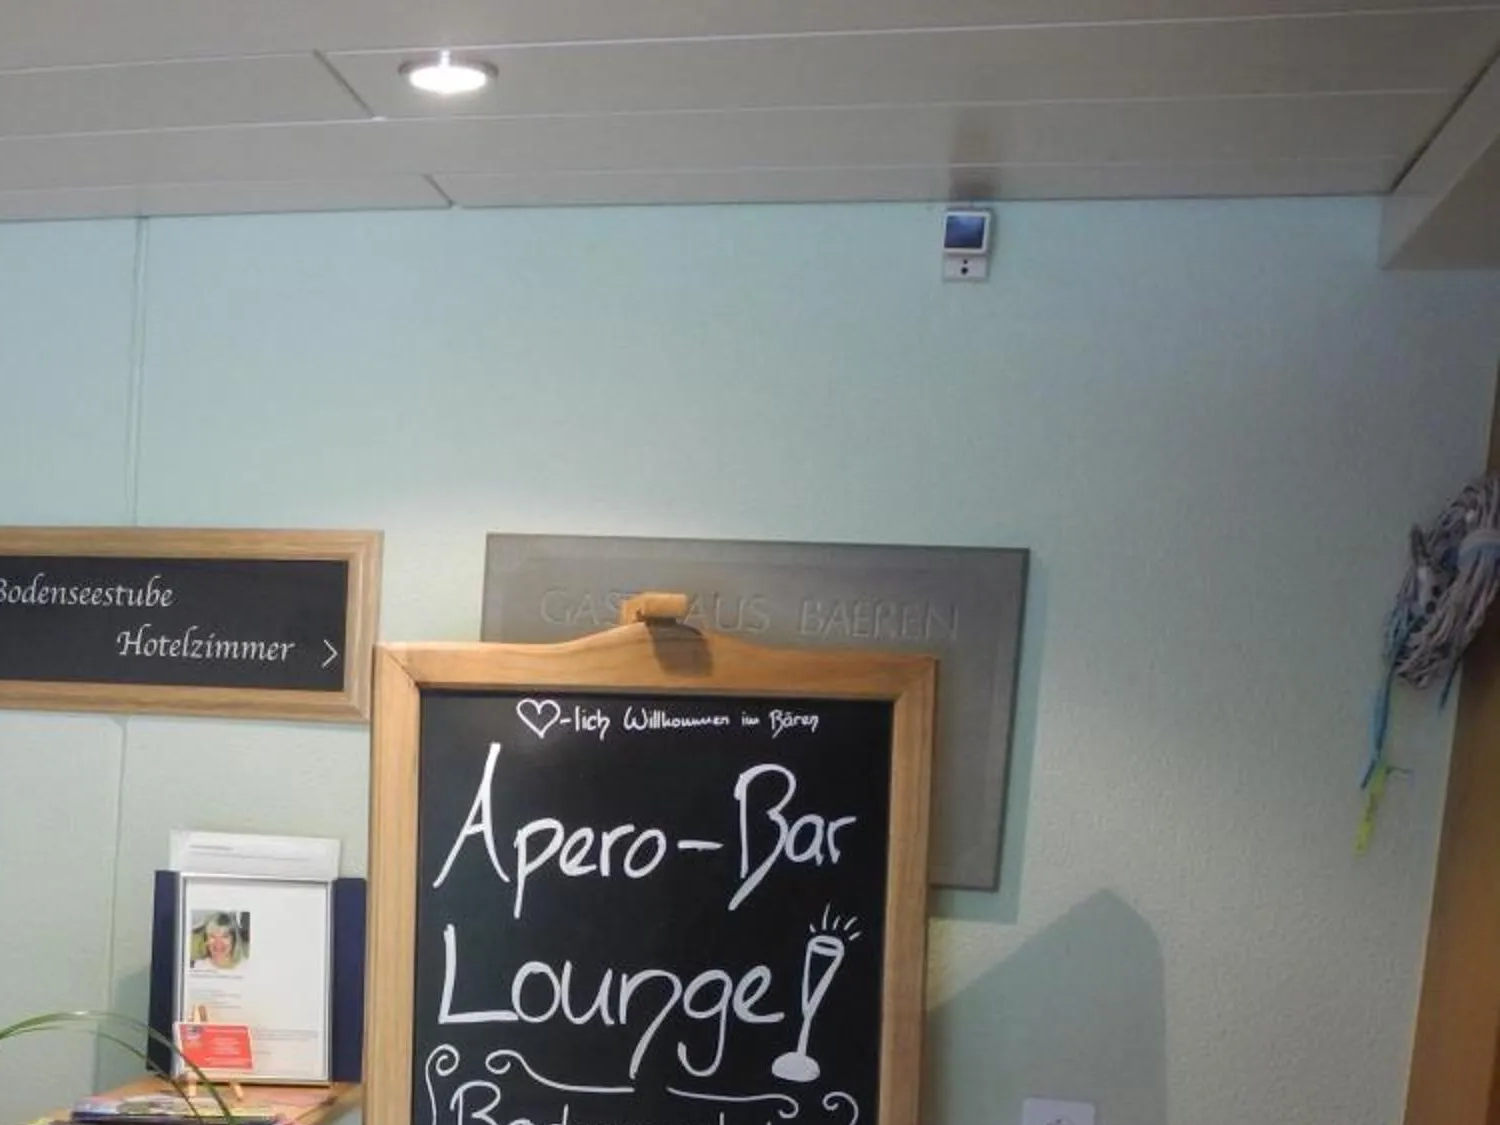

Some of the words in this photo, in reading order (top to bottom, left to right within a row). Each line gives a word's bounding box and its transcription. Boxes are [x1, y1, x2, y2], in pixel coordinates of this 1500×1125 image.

[540, 586, 771, 634] GASAUS
[116, 623, 297, 663] Hotelzimmer
[769, 709, 820, 739] Bären
